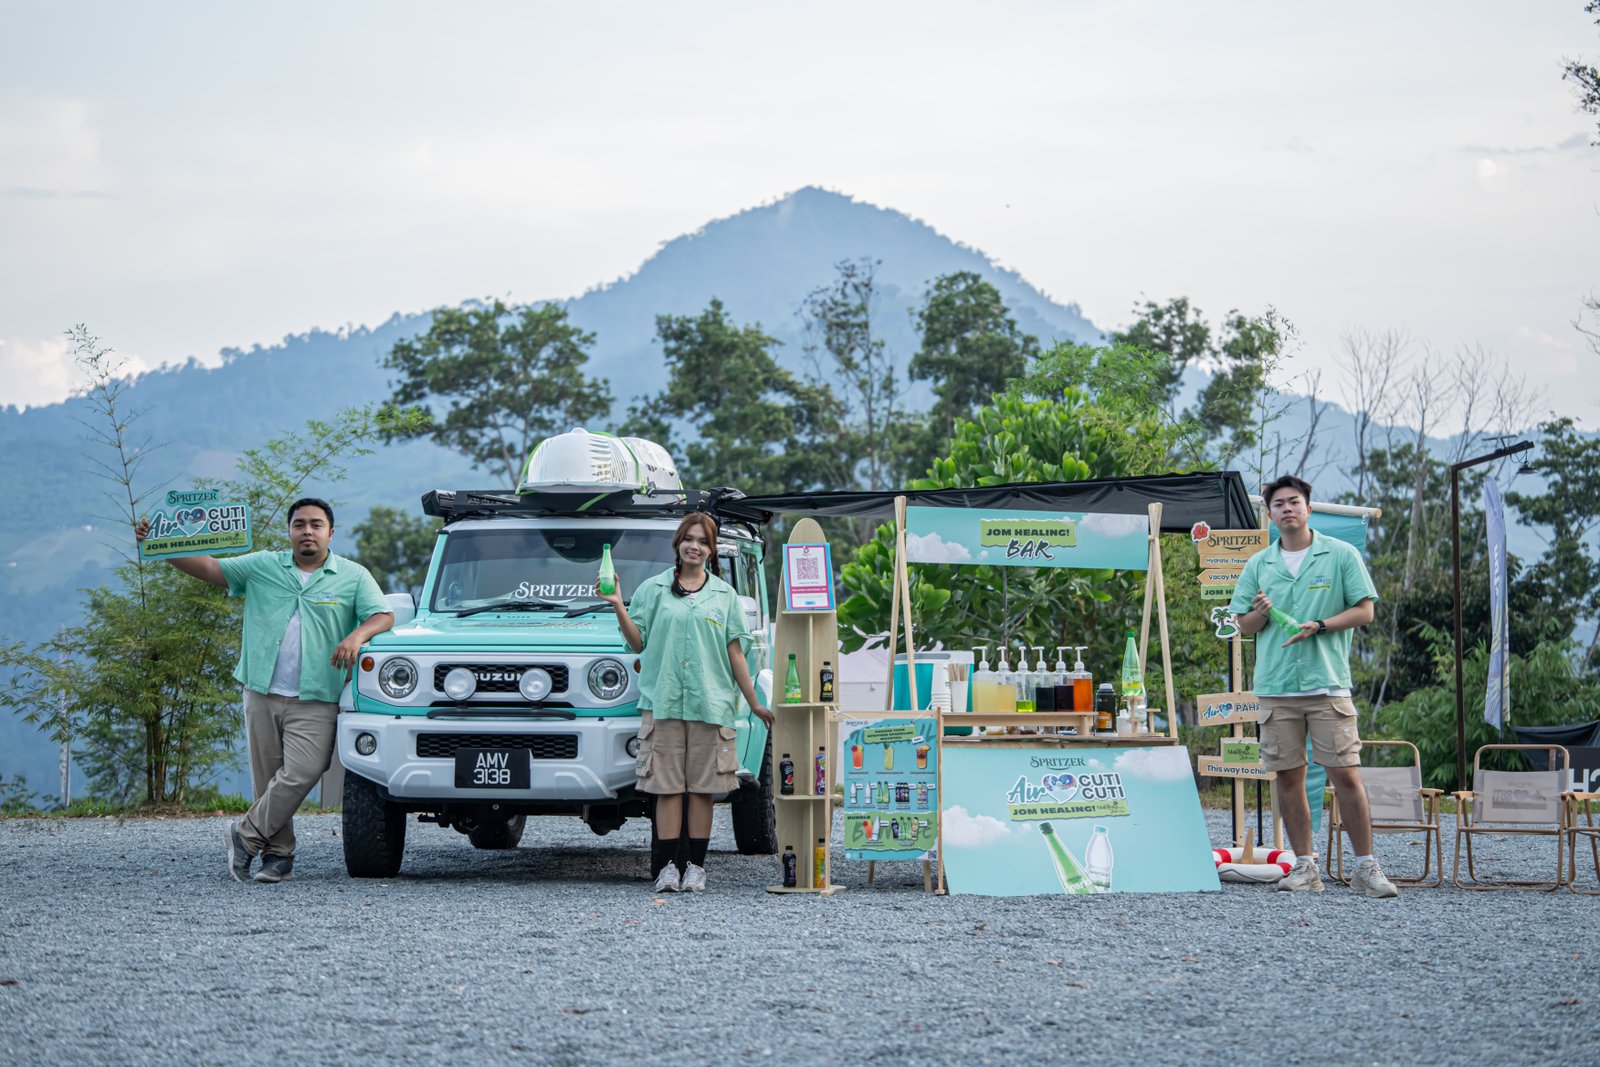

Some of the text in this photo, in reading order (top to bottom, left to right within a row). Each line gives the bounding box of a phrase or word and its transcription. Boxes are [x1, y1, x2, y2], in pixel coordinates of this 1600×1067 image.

[168, 491, 217, 504] SPRITZER
[208, 506, 245, 519] CUTI
[147, 512, 178, 538] Air
[209, 518, 246, 532] CUTI
[986, 528, 1070, 537] JOM HEALING!
[146, 541, 168, 550] JOM
[170, 538, 219, 548] HEALING!
[1207, 534, 1261, 547] SPRITZER
[1006, 539, 1054, 560] BAR
[515, 581, 598, 599] SPRITZER
[475, 752, 509, 768] AMV
[1030, 756, 1086, 768] SPRITZER
[1207, 764, 1222, 772] This
[1223, 766, 1239, 775] way
[473, 768, 511, 785] 3138
[1079, 773, 1120, 787] CUTI
[1008, 776, 1045, 803] Air
[1081, 787, 1125, 800] CUTI
[1012, 808, 1038, 816] JOM
[1040, 805, 1096, 815] HEALING!
